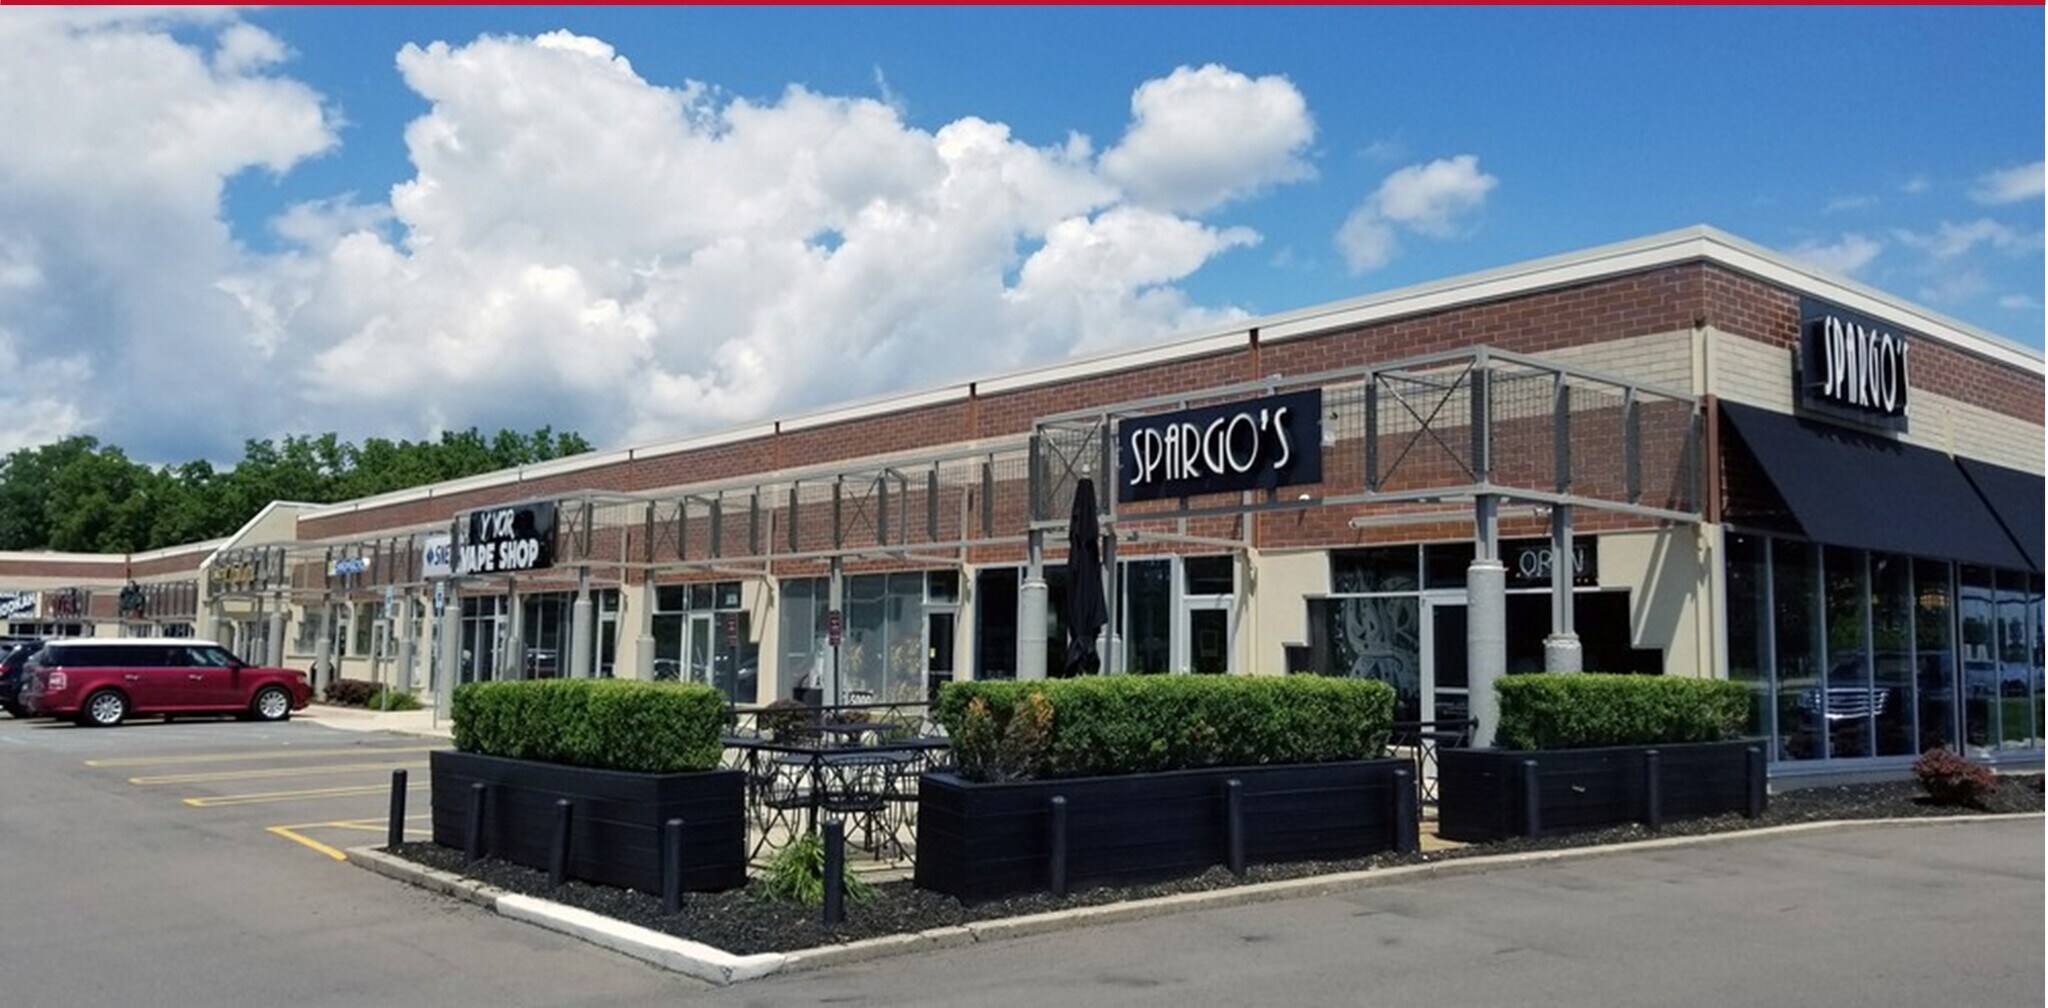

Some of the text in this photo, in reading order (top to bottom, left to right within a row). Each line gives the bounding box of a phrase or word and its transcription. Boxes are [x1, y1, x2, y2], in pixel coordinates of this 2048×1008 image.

[1825, 315, 1910, 417] SPARGO'S
[1130, 406, 1290, 485] SPARGO'S
[461, 538, 540, 573] VAPE SHOP
